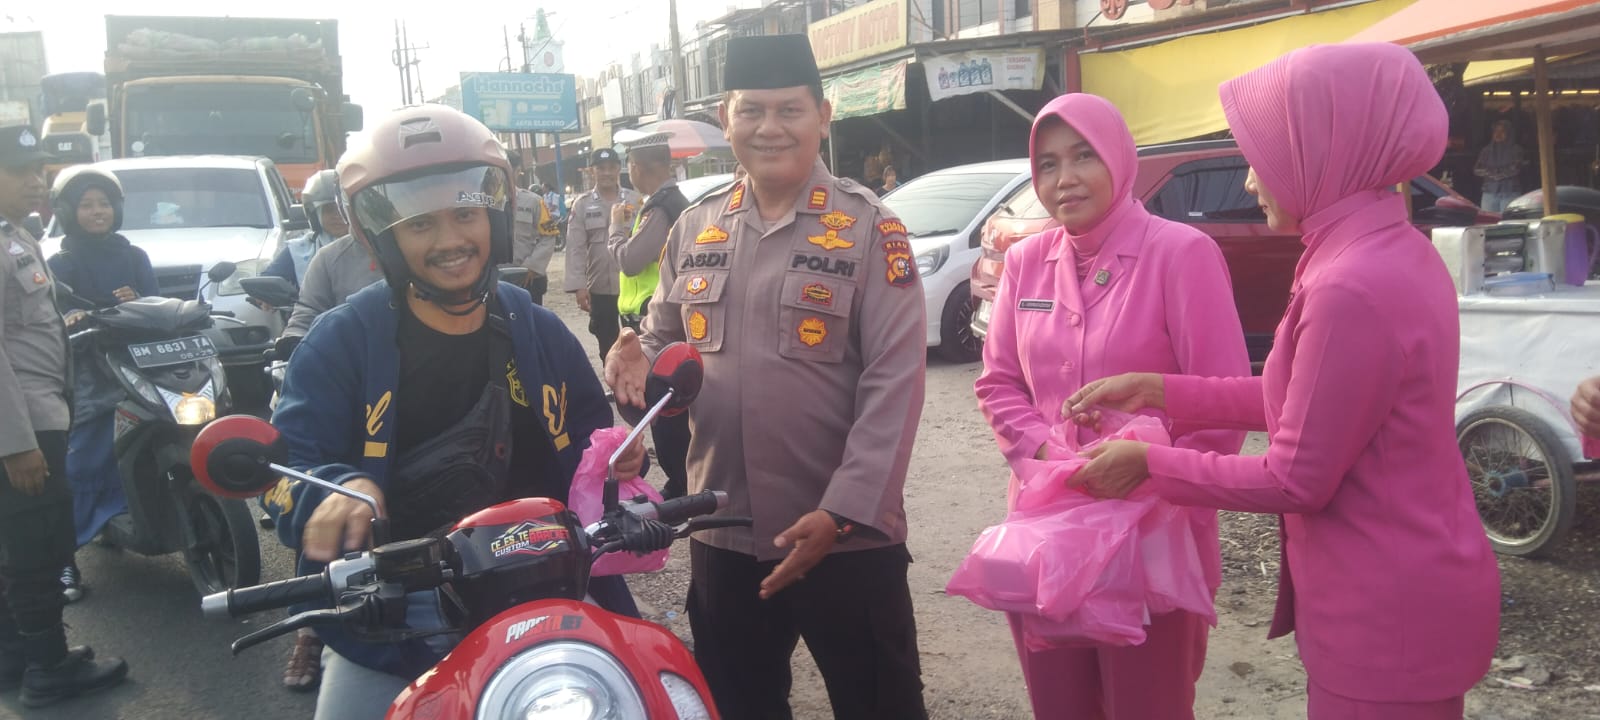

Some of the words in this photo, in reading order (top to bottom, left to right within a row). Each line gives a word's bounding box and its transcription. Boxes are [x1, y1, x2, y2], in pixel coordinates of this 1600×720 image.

[859, 2, 900, 50] MOTOR
[475, 76, 564, 93] Hannochs
[886, 241, 908, 249] RIAU
[681, 253, 727, 269] ASDI
[792, 254, 856, 277] POLRI
[132, 347, 151, 357] BM
[156, 341, 187, 353] 6631
[193, 338, 210, 348] TA
[495, 541, 529, 557] CUSTOM
